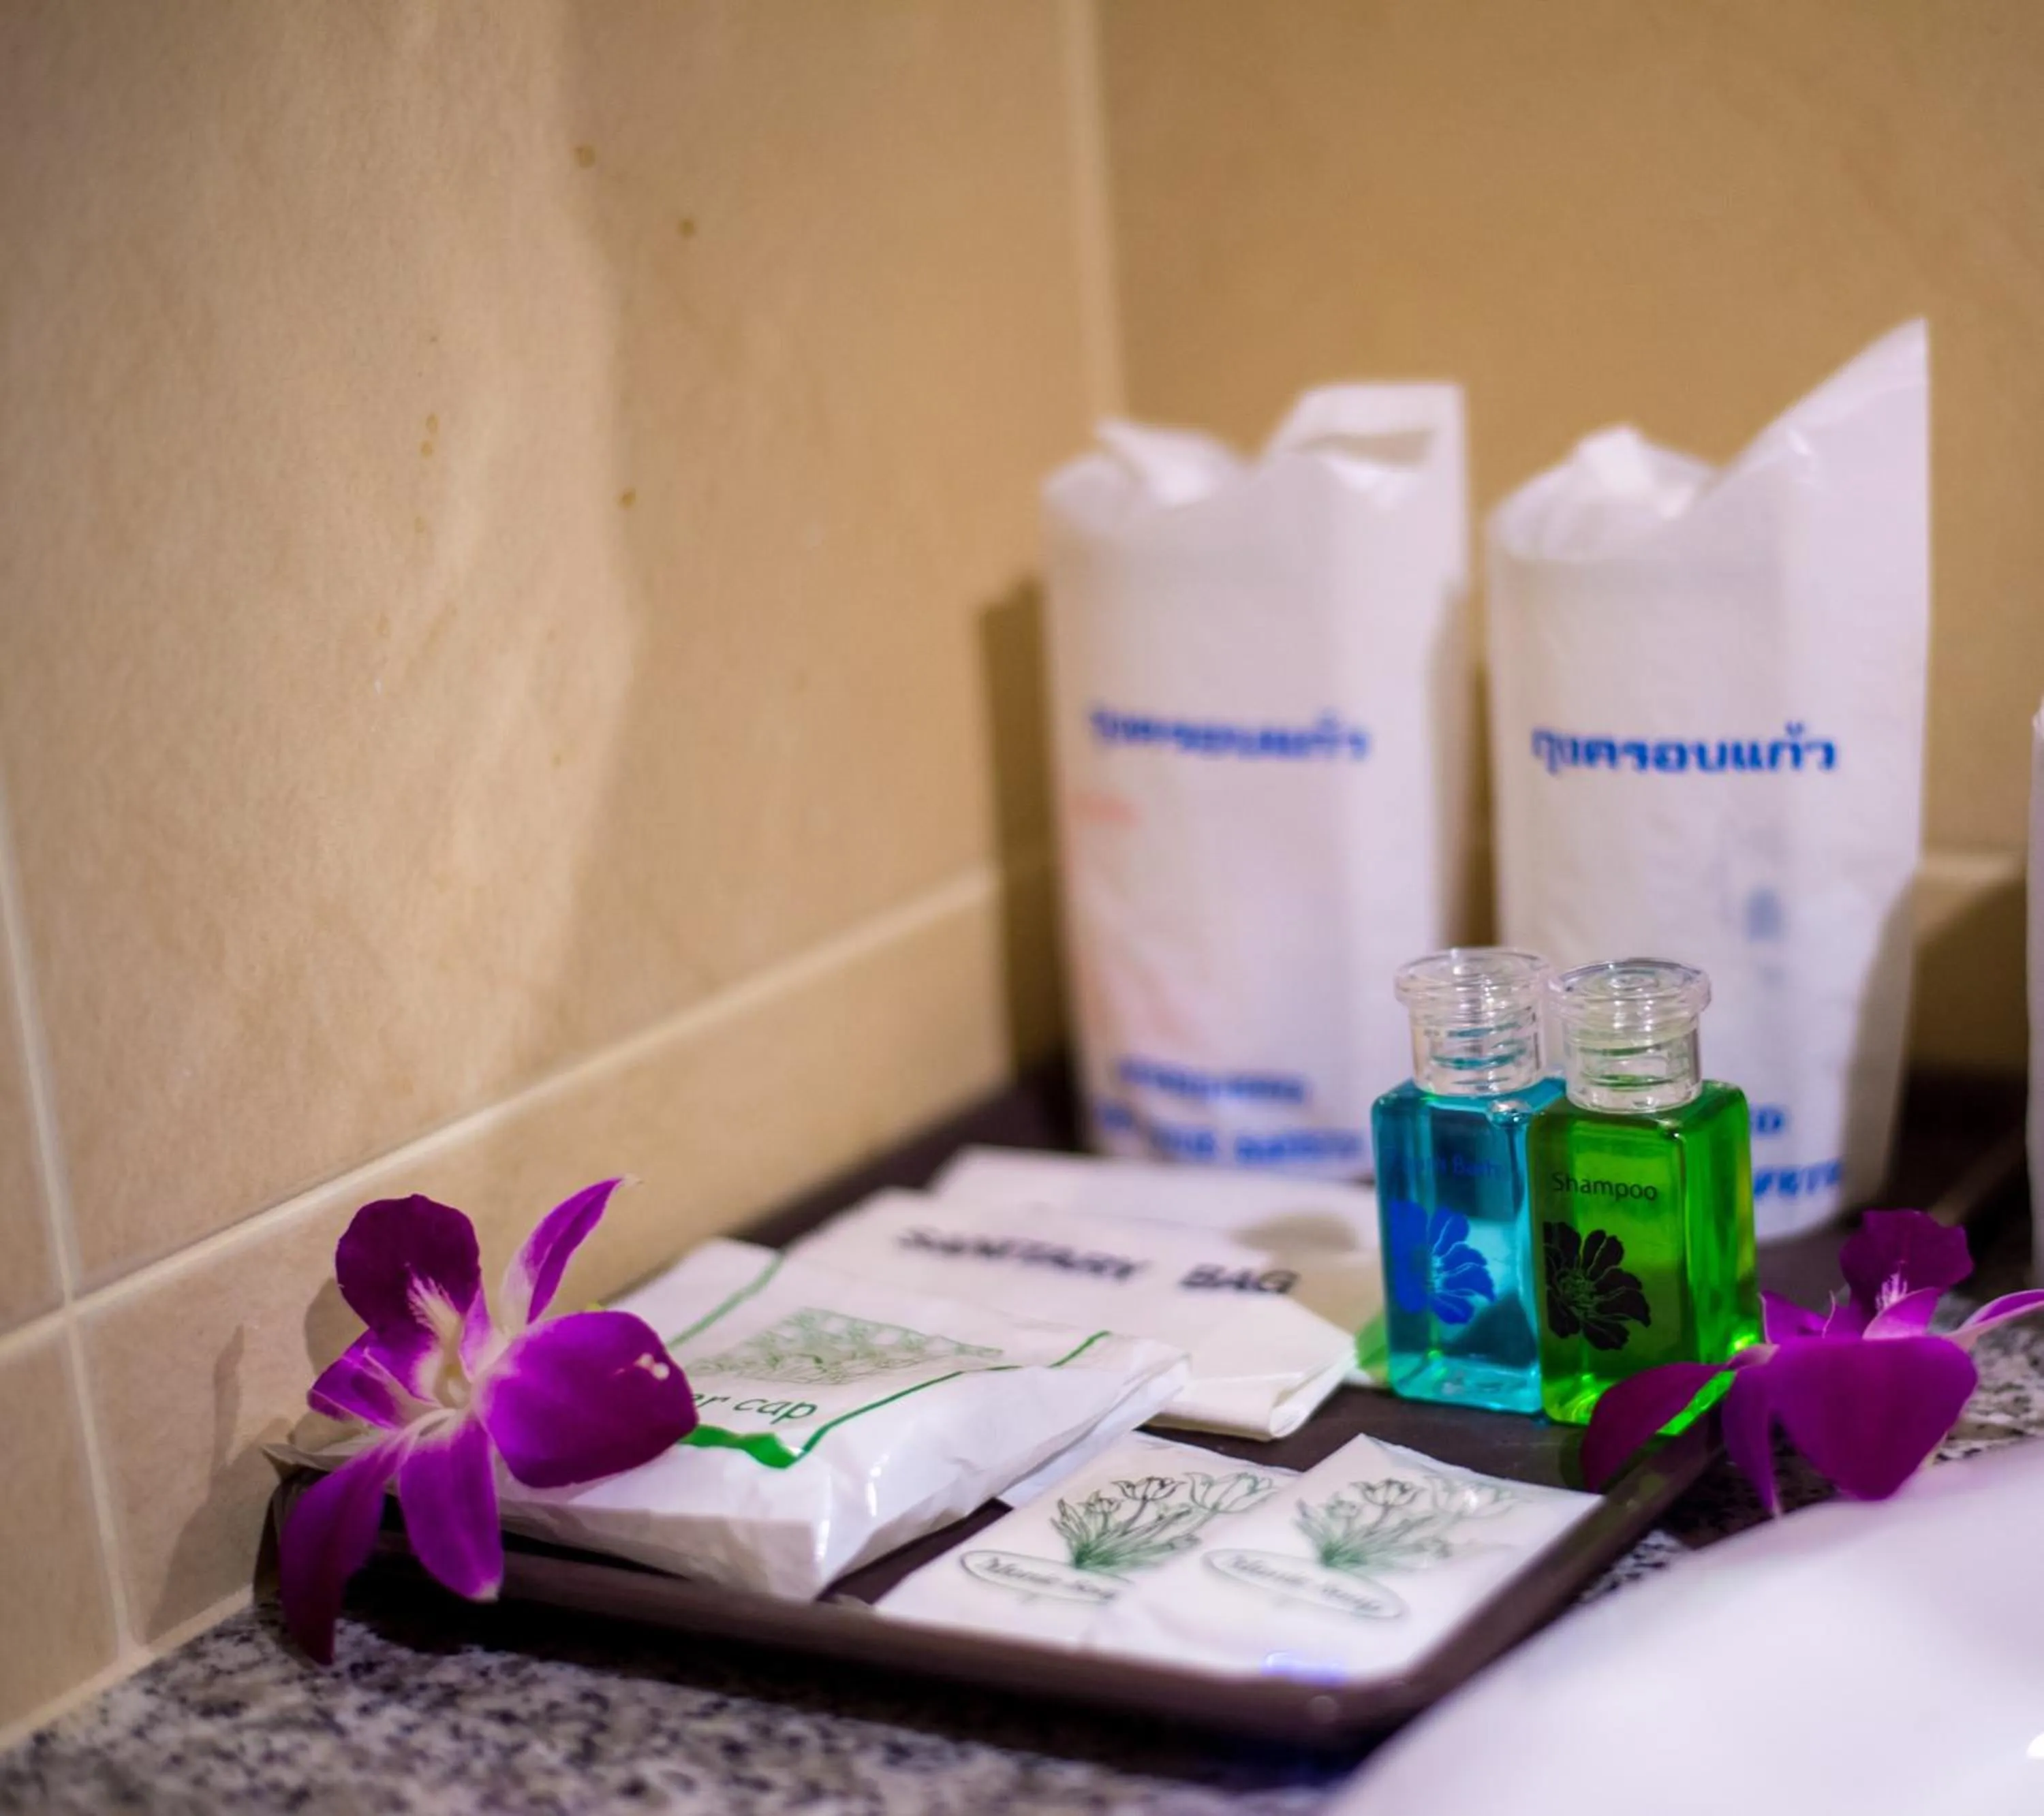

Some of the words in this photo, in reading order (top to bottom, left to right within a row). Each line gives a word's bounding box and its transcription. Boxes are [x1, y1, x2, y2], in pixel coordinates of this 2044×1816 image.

[1551, 1171, 1658, 1202] Shampoo
[1179, 1264, 1299, 1295] BAG
[732, 1398, 818, 1425] cap
